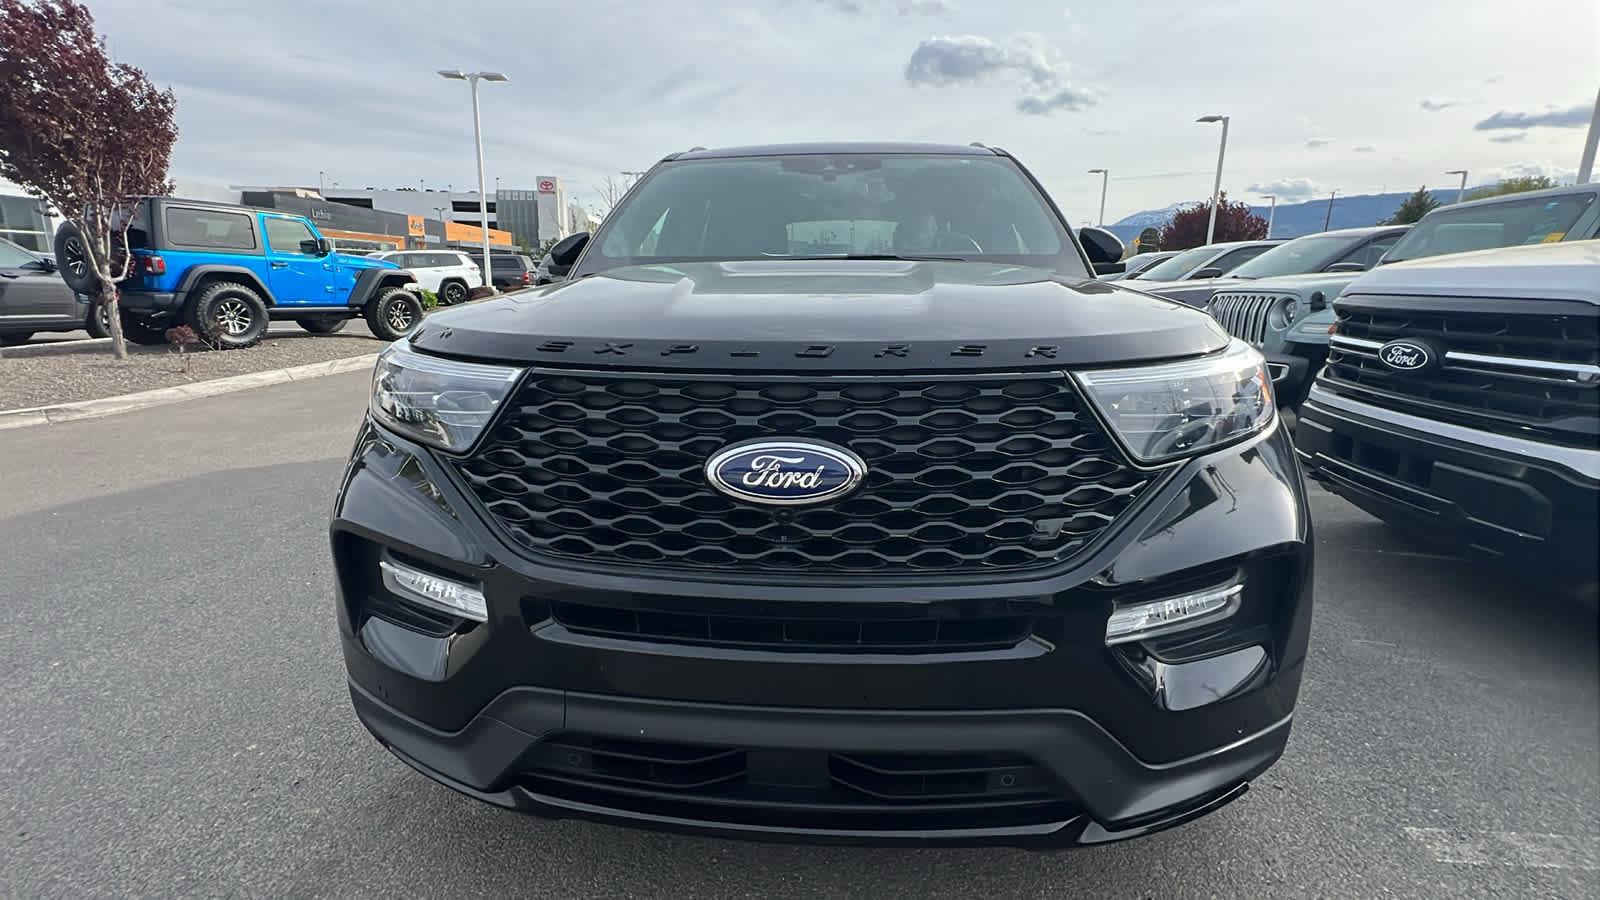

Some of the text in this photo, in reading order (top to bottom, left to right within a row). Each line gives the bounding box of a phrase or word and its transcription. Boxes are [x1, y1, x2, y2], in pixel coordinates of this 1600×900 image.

[536, 340, 1059, 358] EXPLORER
[1387, 346, 1419, 366] Ford
[743, 455, 825, 488] Ford
